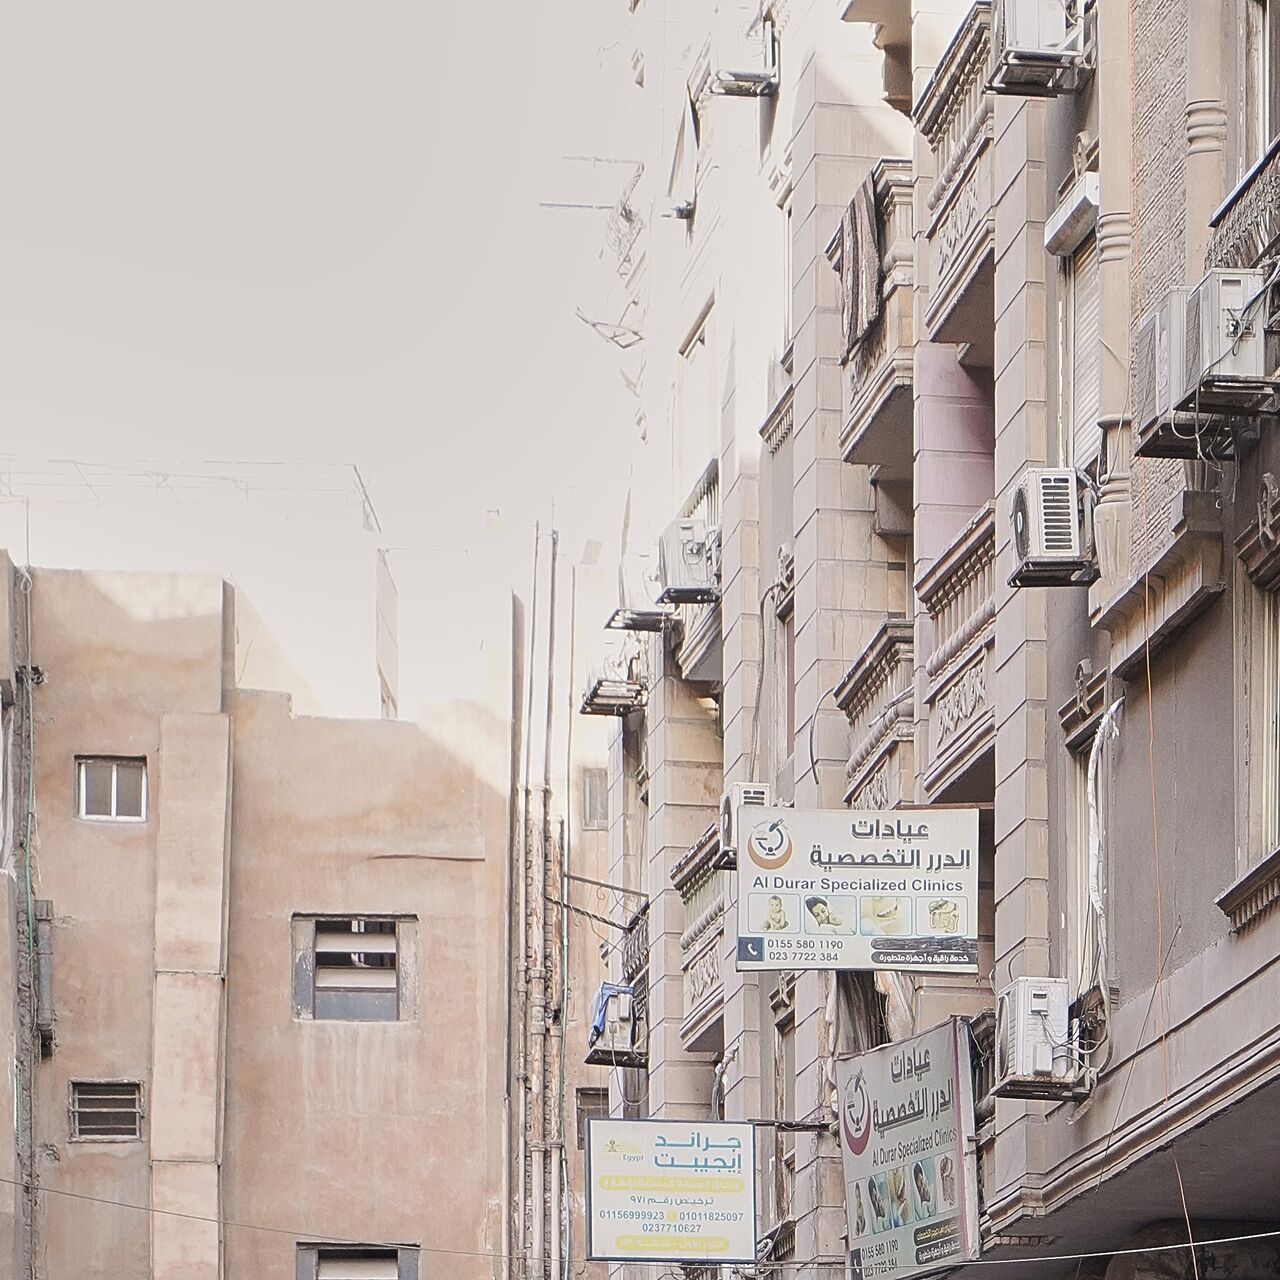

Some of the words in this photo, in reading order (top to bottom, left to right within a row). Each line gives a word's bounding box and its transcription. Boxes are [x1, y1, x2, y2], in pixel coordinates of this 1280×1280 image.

[852, 818, 929, 844] عيادات
[810, 845, 921, 872] التخصصية
[926, 849, 971, 874] الدرر
[753, 876, 768, 889] Al
[773, 877, 816, 890] Durar
[820, 878, 907, 892] Specialized
[911, 880, 964, 892] Clinics
[767, 939, 793, 948] 0155
[796, 940, 815, 949] 580
[820, 940, 843, 949] 1190
[769, 952, 788, 961] 023
[792, 952, 816, 961] 7722
[820, 952, 839, 961] 384
[890, 1046, 931, 1084] عيادات
[931, 1077, 955, 1122] الدرر
[873, 1087, 929, 1139] التخصصية
[654, 1131, 742, 1153] جراند
[872, 1148, 880, 1168] Al
[880, 1146, 898, 1166] Durar
[898, 1133, 934, 1162] Specialized
[934, 1126, 957, 1146] Clinics
[622, 1154, 644, 1163] Egypt
[654, 1153, 742, 1174] إيجيبت
[630, 1195, 646, 1204] ٩٧١
[647, 1197, 674, 1206] رقم
[674, 1197, 714, 1207] ترخيص
[599, 1210, 665, 1220] 01156999923
[679, 1212, 744, 1222] 01011825097
[642, 1223, 702, 1233] 0237710627
